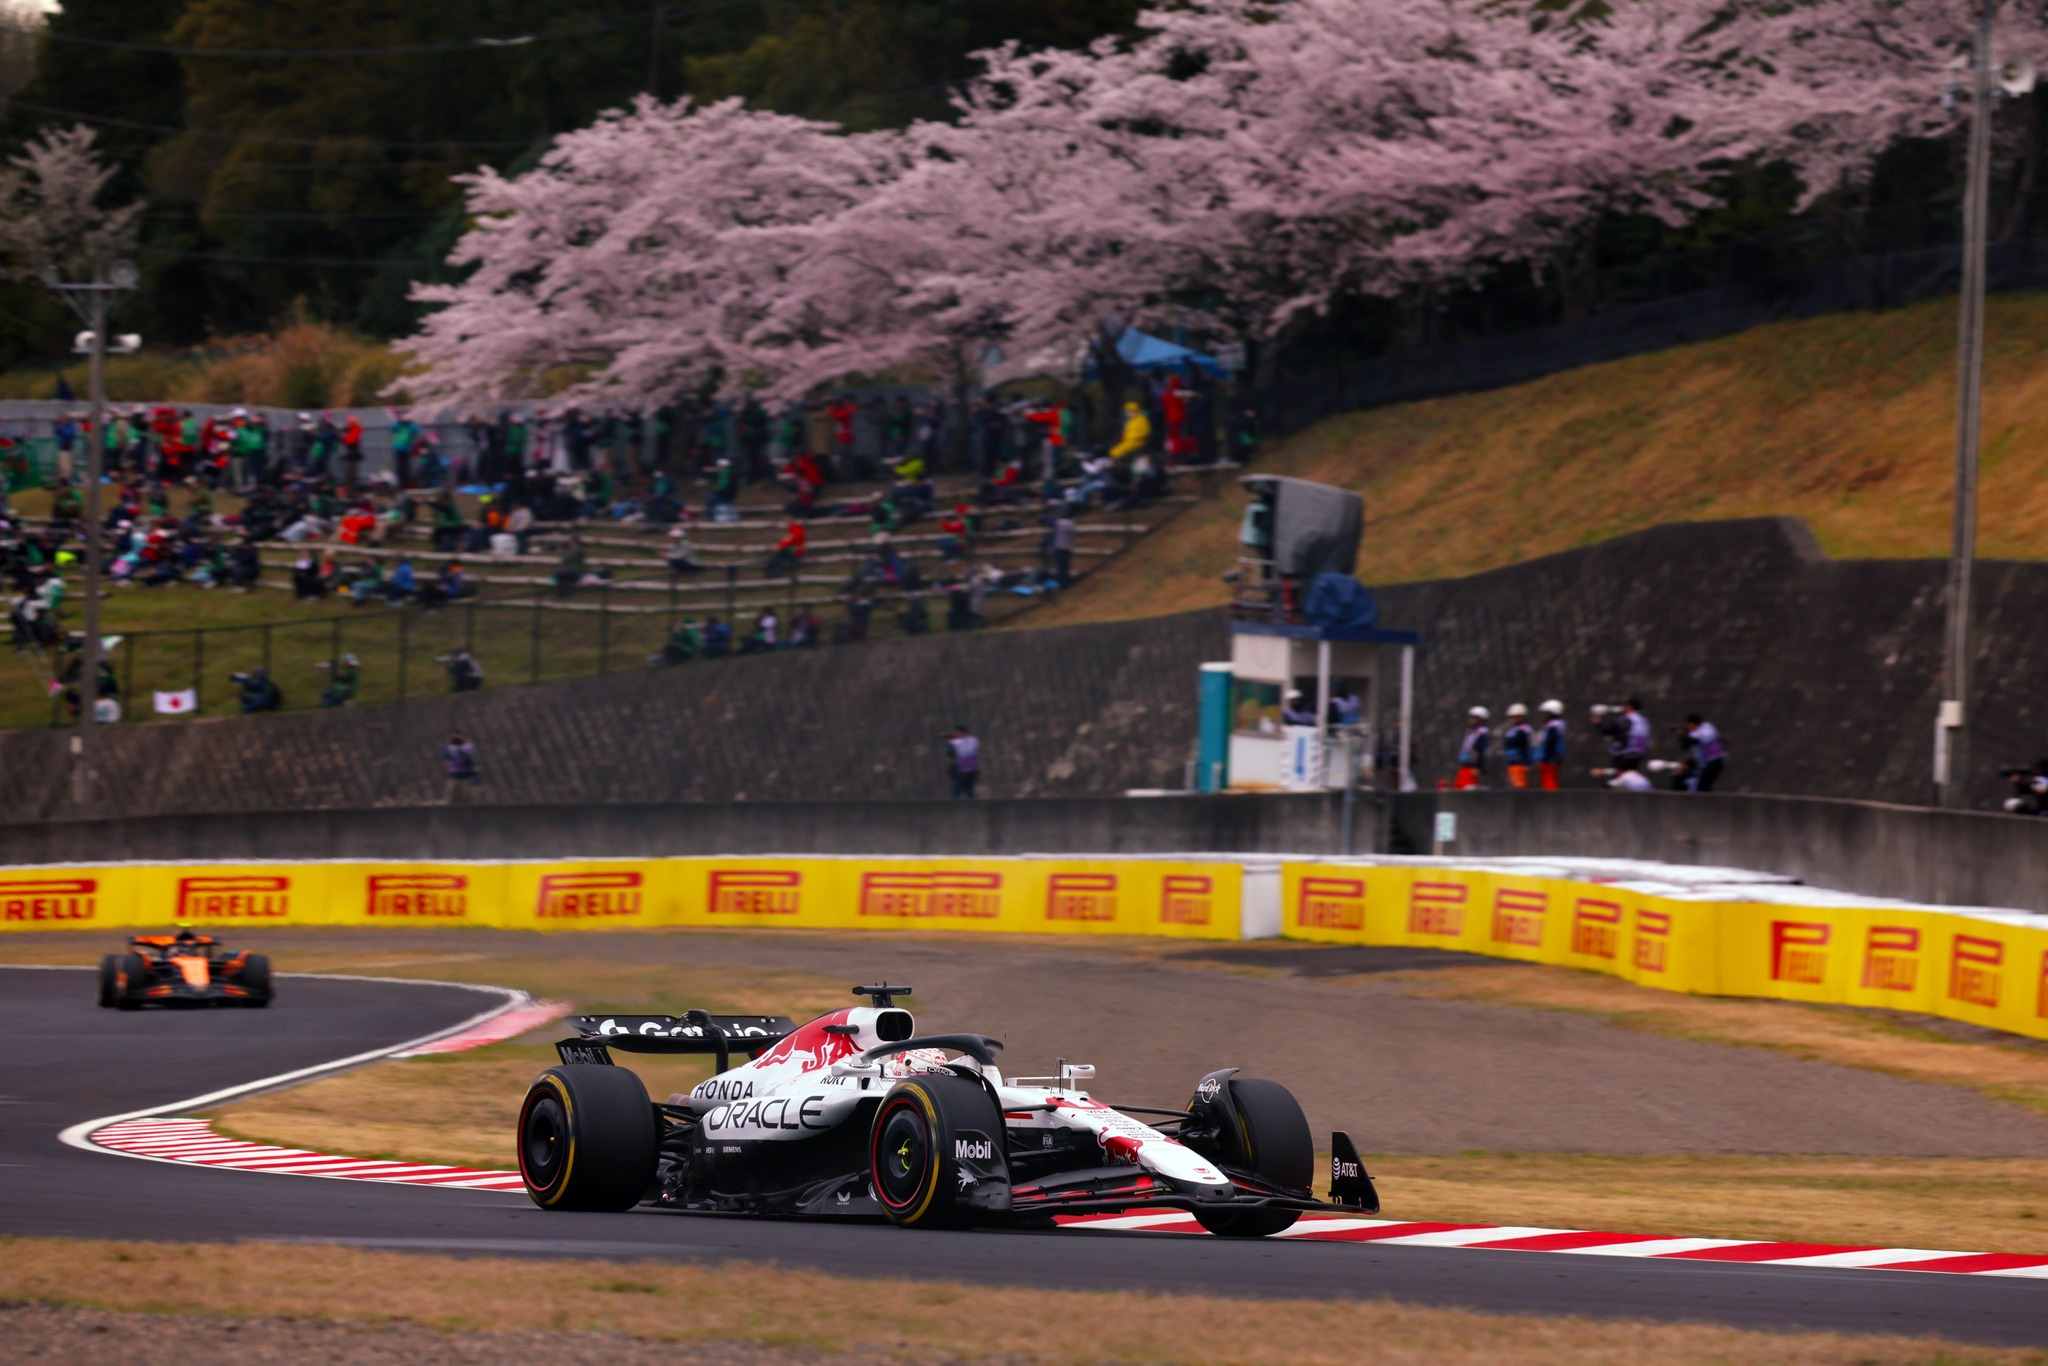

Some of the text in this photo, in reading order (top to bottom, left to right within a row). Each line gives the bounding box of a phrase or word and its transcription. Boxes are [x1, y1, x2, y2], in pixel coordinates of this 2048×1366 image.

[176, 876, 290, 917] PIRELLI
[366, 875, 468, 917] PIRELLI
[537, 872, 643, 917] PIRELLI
[707, 870, 802, 913] PIRELLI
[694, 1080, 753, 1100] HONDA
[709, 1096, 832, 1131] ORACLE
[955, 1140, 991, 1160] Mobil
[1341, 1162, 1358, 1177] AT&T
